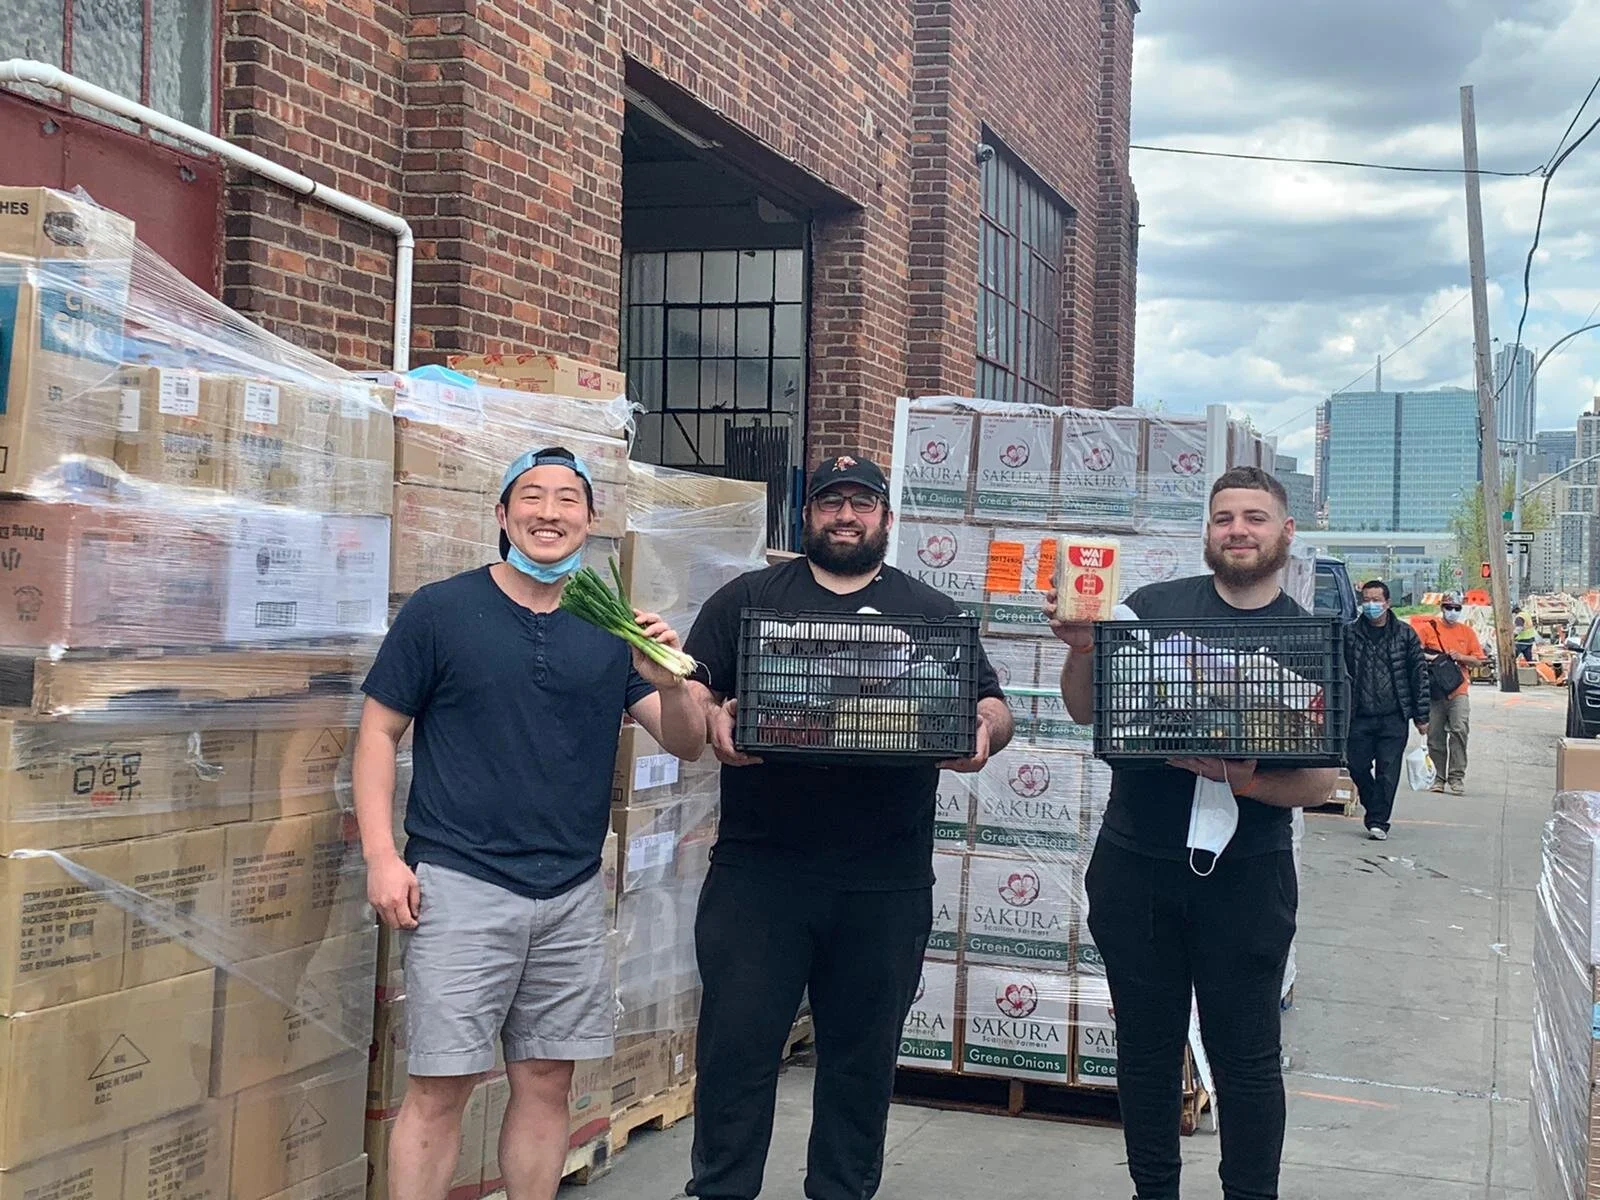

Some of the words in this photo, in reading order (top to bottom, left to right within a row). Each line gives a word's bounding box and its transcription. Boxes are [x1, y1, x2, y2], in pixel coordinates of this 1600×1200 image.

[0, 201, 29, 215] HES
[982, 469, 1044, 484] SAKURA
[1080, 548, 1104, 558] WAI
[1080, 557, 1103, 568] WAI
[995, 608, 1035, 622] Green
[984, 797, 1073, 821] SAKURA
[935, 825, 960, 839] ions
[981, 829, 1020, 845] Green
[974, 905, 1062, 931] SAKURA
[970, 937, 1010, 953] Green
[1014, 942, 1062, 959] Onions
[972, 1016, 1060, 1042] SAKURA
[901, 1041, 946, 1058] Onions
[969, 1048, 1009, 1066] Green
[1013, 1053, 1060, 1071] Onions
[1083, 1060, 1117, 1075] Gree
